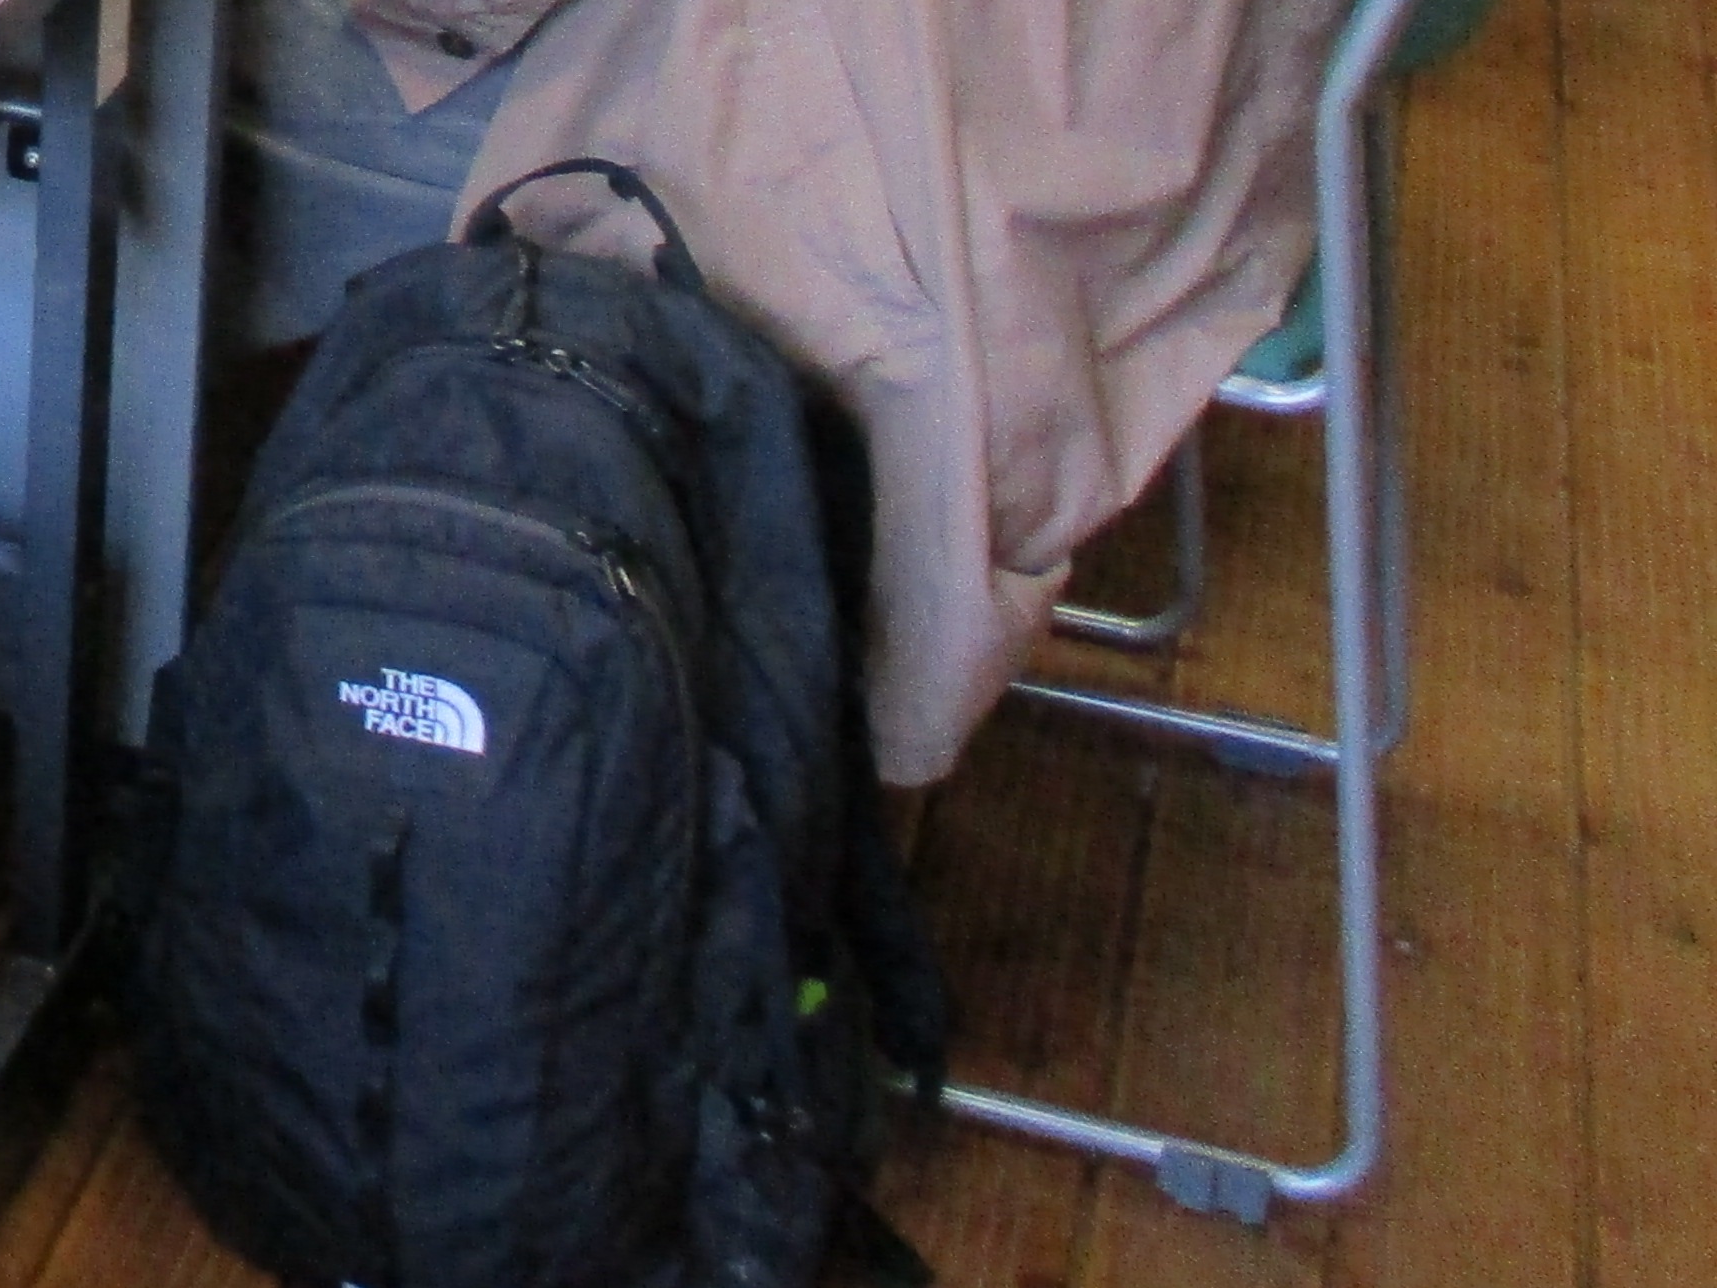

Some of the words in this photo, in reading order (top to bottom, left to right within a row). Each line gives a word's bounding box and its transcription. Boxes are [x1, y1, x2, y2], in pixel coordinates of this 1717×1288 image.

[380, 667, 436, 696] THE
[339, 681, 436, 717] NORTH
[363, 709, 435, 742] FACE
